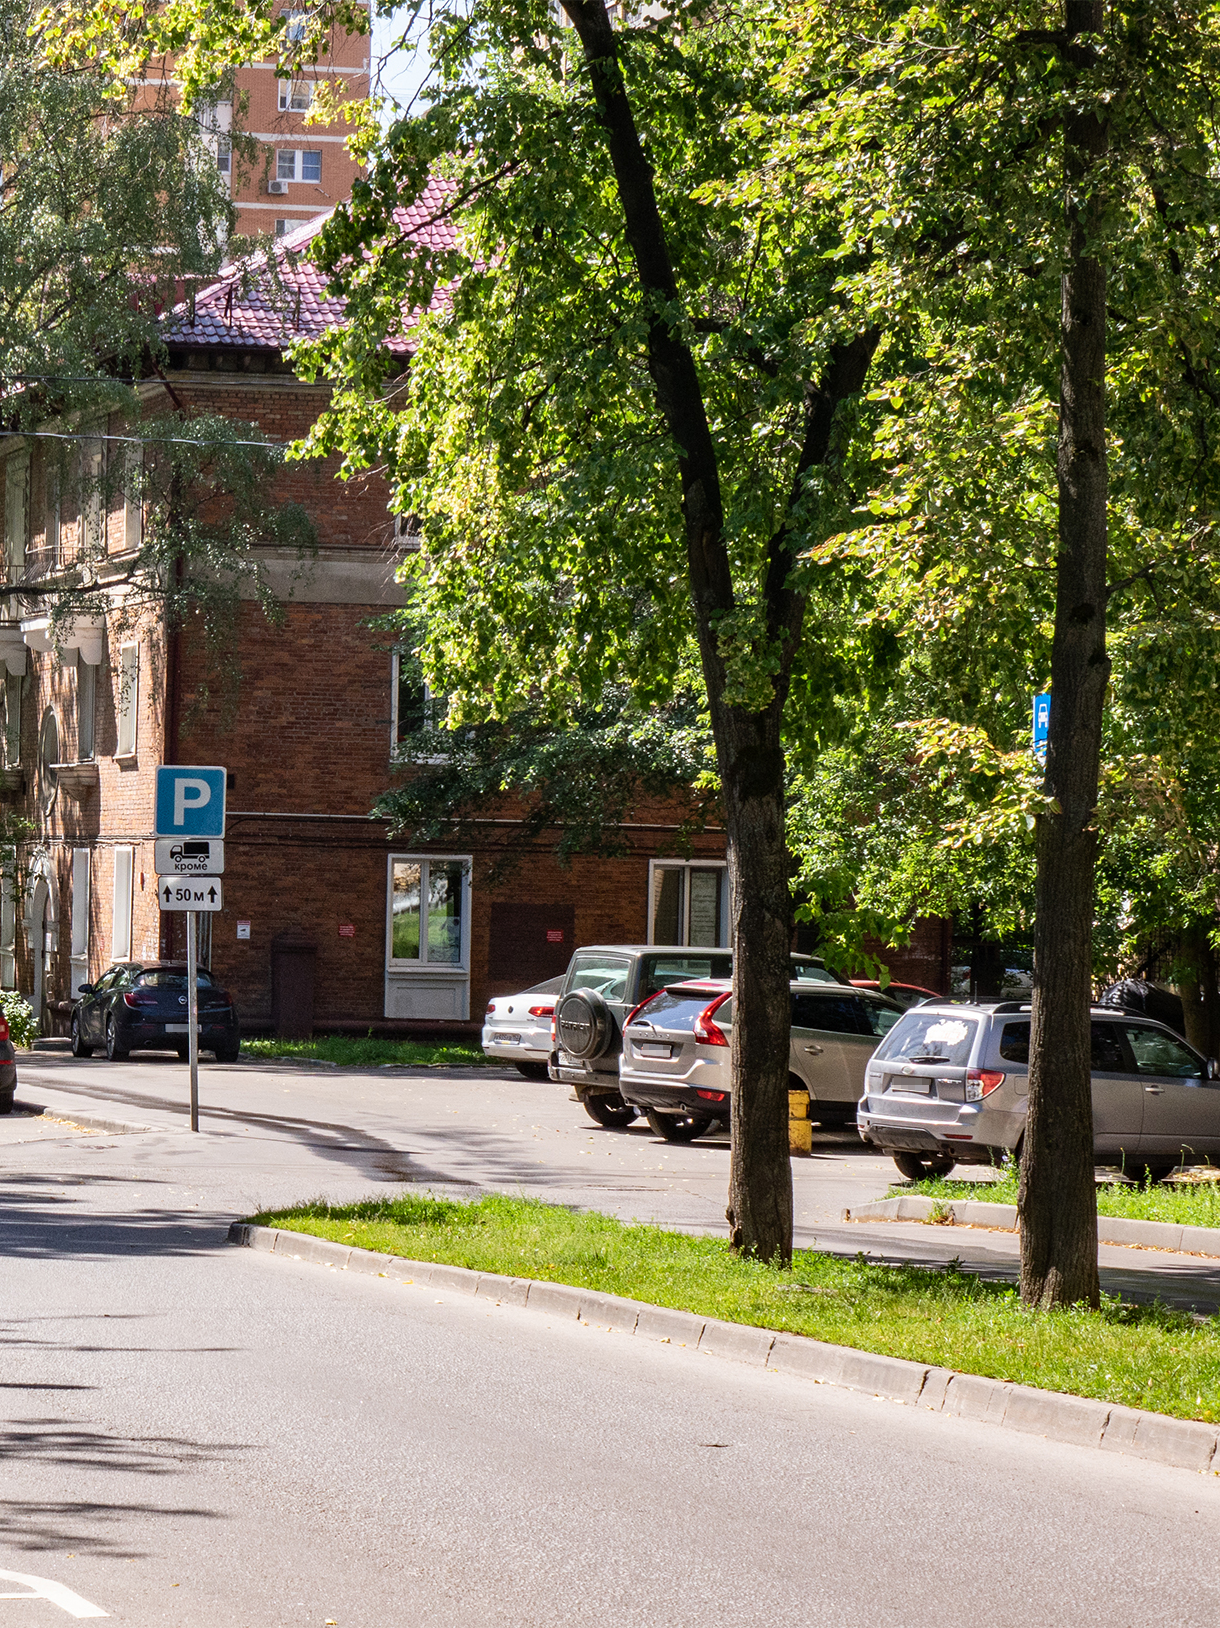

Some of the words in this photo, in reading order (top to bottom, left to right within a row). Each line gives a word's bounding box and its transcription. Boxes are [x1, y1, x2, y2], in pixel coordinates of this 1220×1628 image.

[174, 778, 211, 826] P
[174, 863, 208, 872] кроме
[175, 888, 191, 902] 50
[194, 892, 204, 902] м
